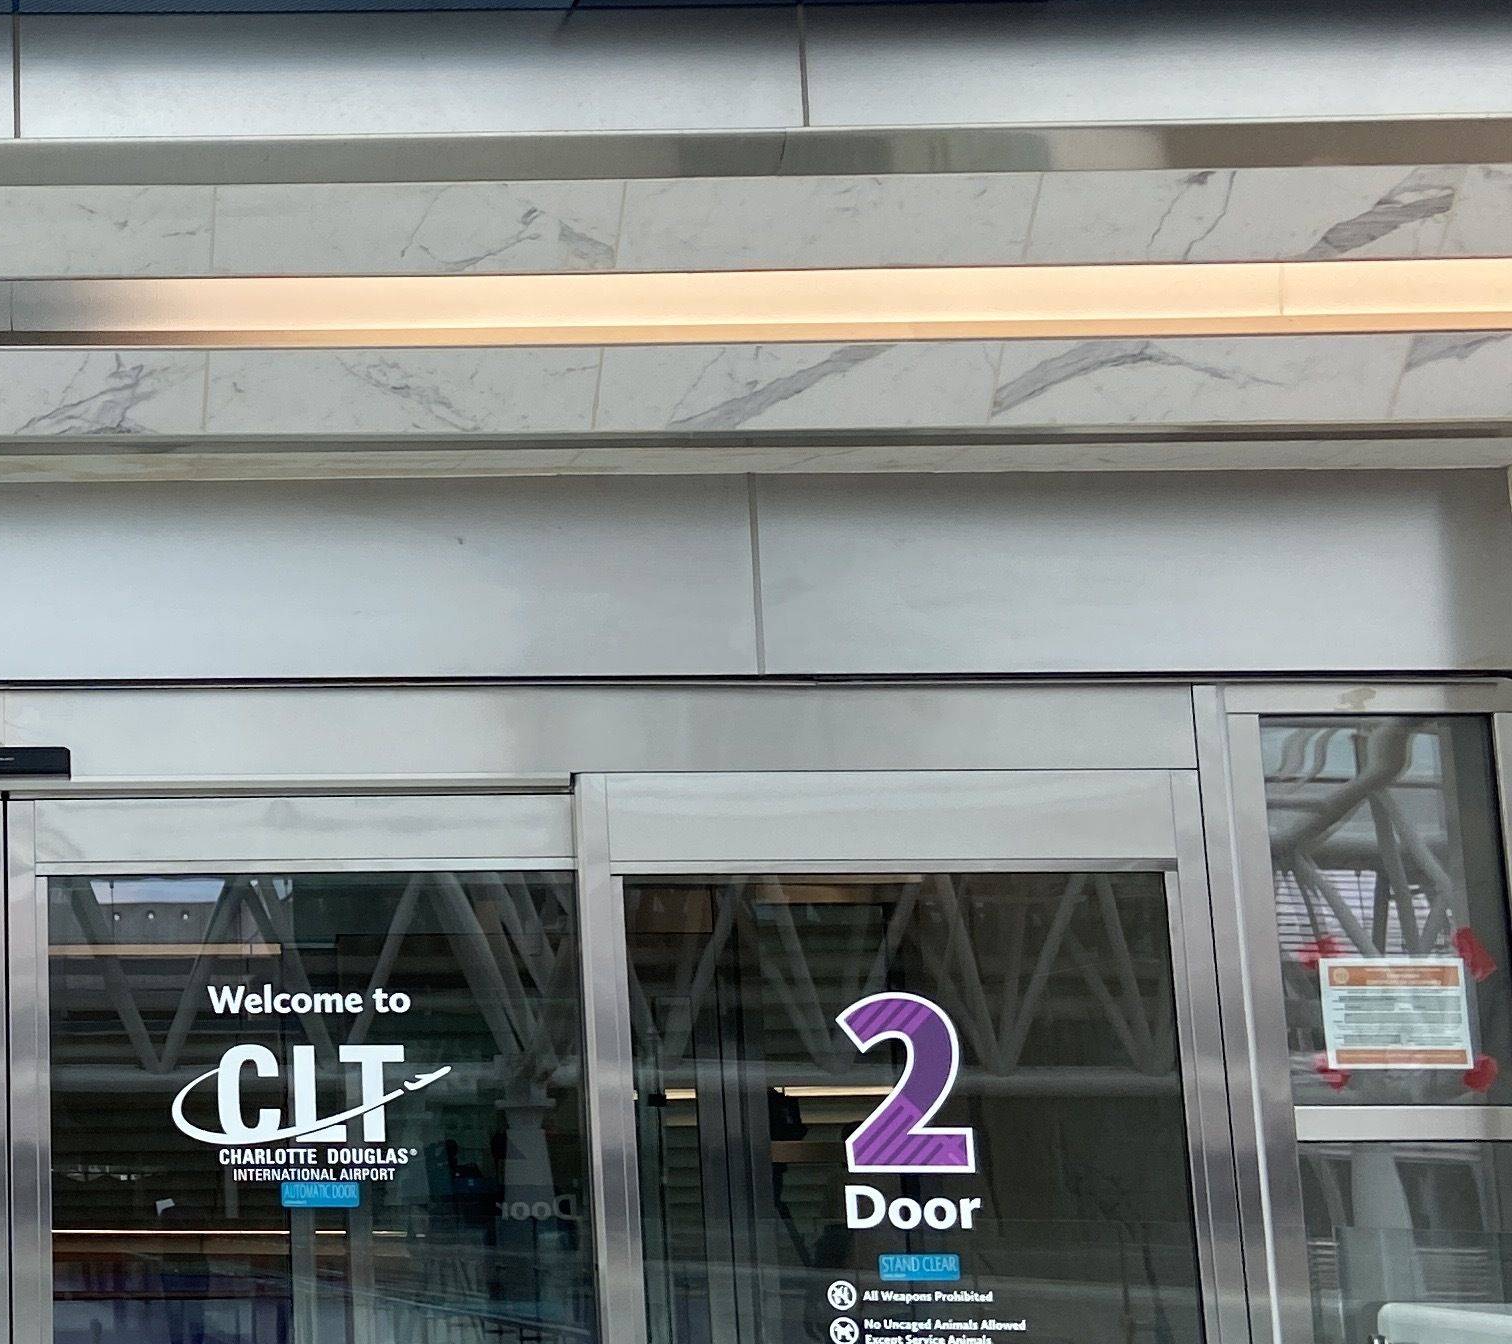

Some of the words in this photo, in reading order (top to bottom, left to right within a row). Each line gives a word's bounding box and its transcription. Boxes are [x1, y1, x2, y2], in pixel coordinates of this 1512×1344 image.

[208, 984, 364, 1014] Welcome
[372, 988, 411, 1013] to
[835, 992, 976, 1173] 2
[218, 1044, 405, 1143] CLT
[219, 1149, 317, 1165] CHARLOTTE
[233, 1168, 337, 1181] INTERNATIONAL
[339, 1167, 396, 1181] AIRPORT
[283, 1184, 330, 1199] AUTOMATIC
[331, 1184, 358, 1199] DOOR
[844, 1185, 981, 1230] Door
[881, 1256, 920, 1273] STAND
[922, 1256, 958, 1272] CLEAR
[863, 1290, 879, 1302] All
[881, 1290, 932, 1304] Weapons
[934, 1290, 994, 1302] Prohibited
[863, 1319, 881, 1330] No
[883, 1318, 932, 1332] Uncaged
[934, 1319, 978, 1330] Animals
[980, 1319, 1027, 1331] Allowed
